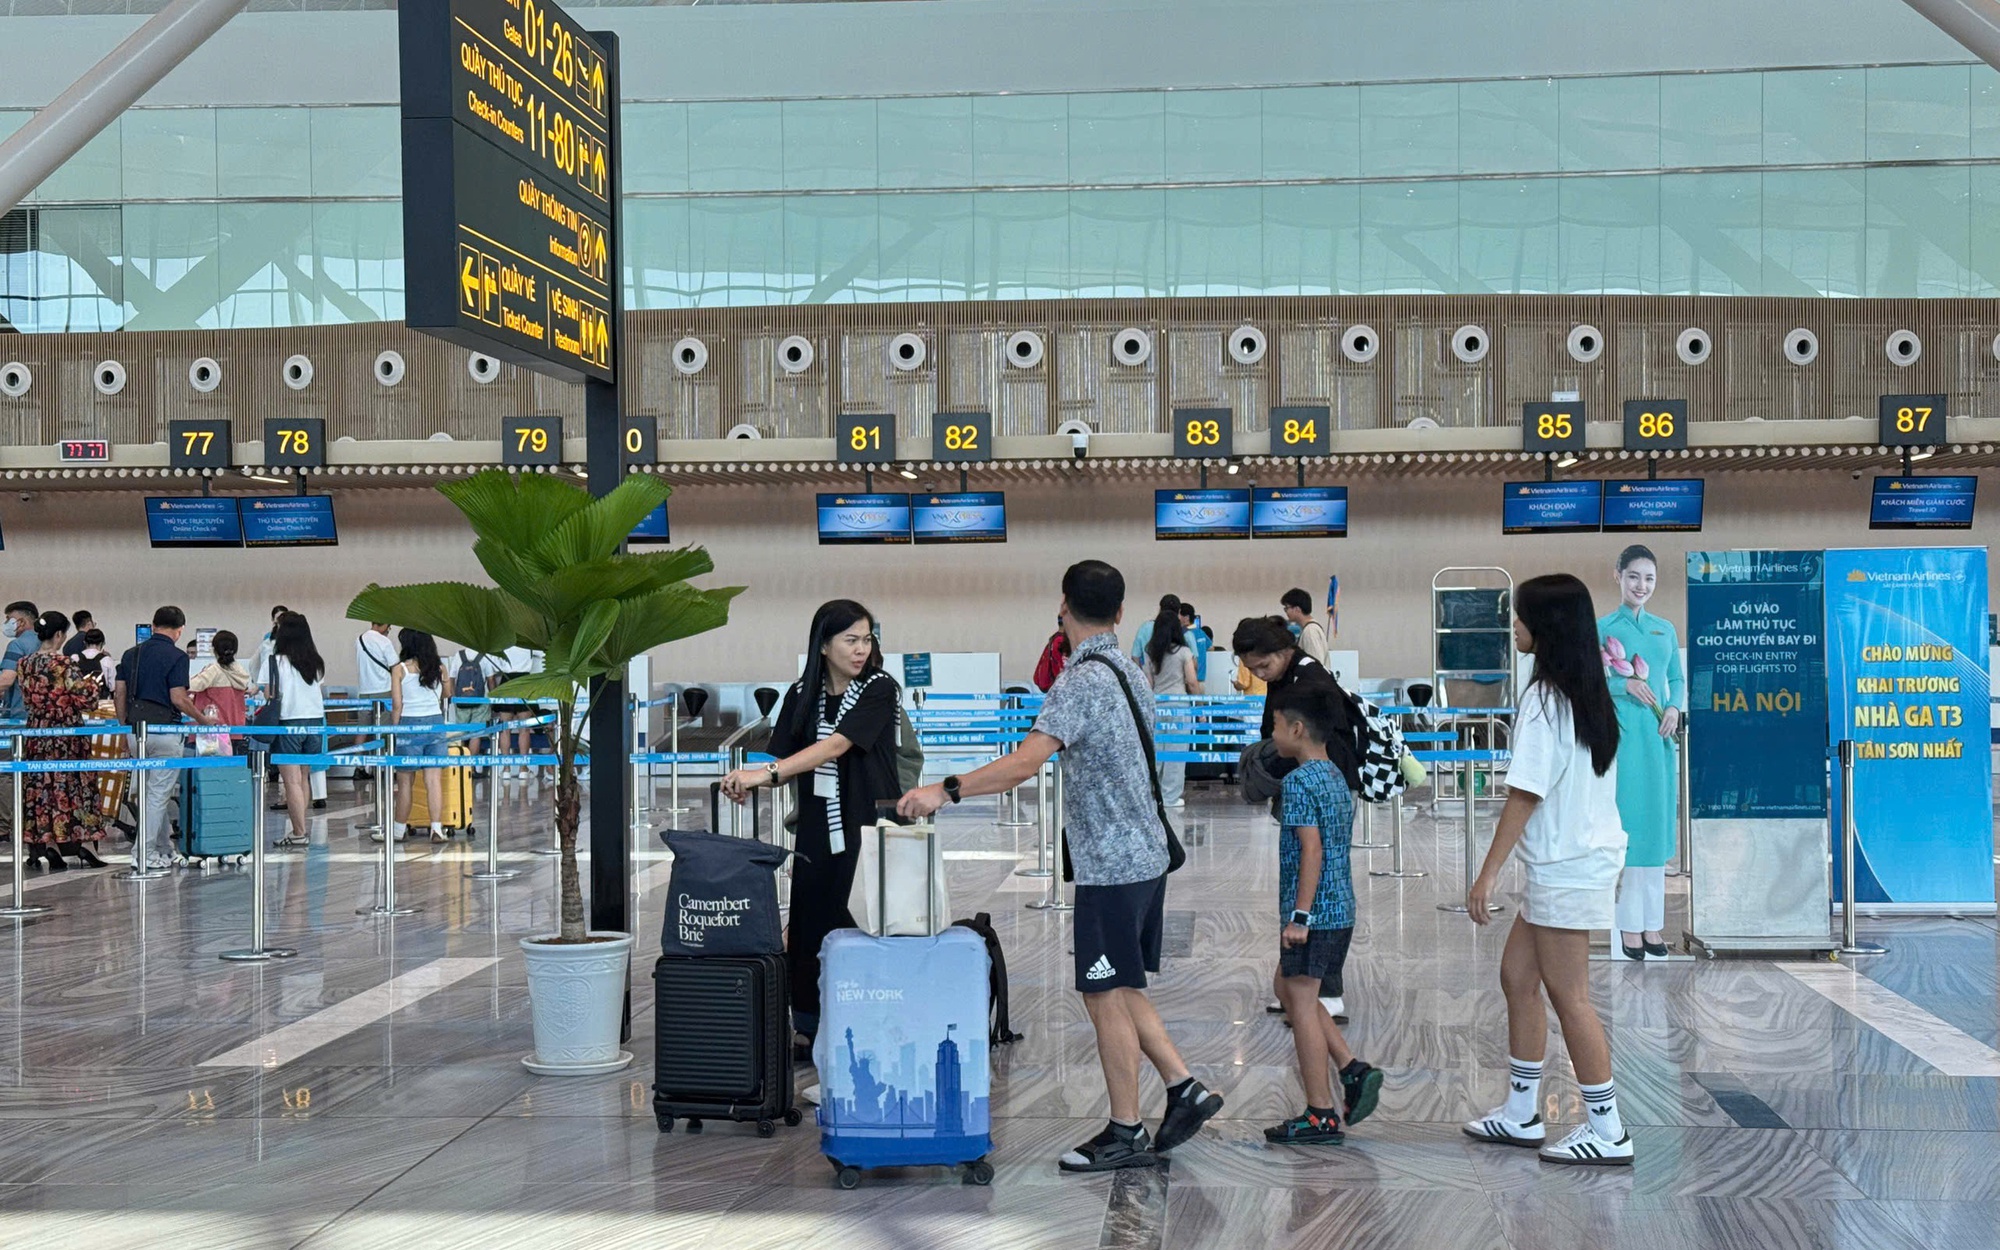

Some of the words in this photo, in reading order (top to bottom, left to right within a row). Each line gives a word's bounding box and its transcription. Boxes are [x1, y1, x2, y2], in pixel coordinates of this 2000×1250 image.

[504, 18, 522, 49] Gates
[524, 0, 573, 87] 01-26
[461, 42, 487, 81] QUẦY
[487, 63, 505, 94] THỦ
[506, 74, 524, 109] TỤC
[468, 90, 497, 126] Check-in
[497, 109, 525, 144] Counters
[527, 93, 575, 176] 11-80
[518, 178, 540, 211] QUẦY
[541, 192, 565, 225] THÔNG
[565, 208, 578, 233] TIN
[549, 234, 578, 267] Information
[502, 263, 524, 297] QUẦY
[525, 275, 537, 302] VÉ
[551, 288, 563, 319] VỆ
[563, 294, 579, 321] SINH
[502, 306, 521, 332] Ticket
[521, 314, 544, 340] Counter
[555, 328, 580, 355] Restroom
[1283, 419, 1317, 444] 84
[1537, 413, 1573, 439] 85
[1639, 412, 1674, 438] 86
[1896, 407, 1932, 432] 87
[182, 431, 215, 455] 77
[277, 430, 310, 455] 78
[515, 428, 548, 452] 79
[625, 428, 643, 453] 0
[851, 426, 880, 450] 81
[945, 425, 978, 450] 82
[1186, 420, 1220, 445] 83
[1529, 502, 1553, 510] KHÁCH
[1718, 563, 1760, 573] Vietnam
[1760, 563, 1798, 572] Airlines
[1866, 572, 1911, 581] Vietnam
[1911, 571, 1951, 580] Airlines
[1733, 601, 1752, 614] LỐI
[1754, 601, 1780, 614] VÀO
[1716, 618, 1742, 630] LÀM
[1744, 616, 1770, 630] THỦ
[1772, 619, 1797, 632] TỤC
[1696, 635, 1723, 646] CHO
[1725, 632, 1775, 645] CHUYẾN
[1778, 635, 1801, 645] BAY
[1803, 634, 1817, 645] ĐI
[1715, 651, 1763, 661] CHECK-IN
[1765, 651, 1798, 660] ENTRY
[1862, 643, 1902, 662] CHÀO
[1905, 643, 1953, 662] MỪNG
[1716, 664, 1737, 673] FOR
[1740, 664, 1781, 673] FLIGHTS
[1782, 664, 1797, 673] TO
[1857, 677, 1894, 693] KHAI
[1896, 675, 1960, 693] TRƯƠNG
[1713, 688, 1749, 712] HÀ
[1756, 688, 1801, 717] NỘI
[1855, 701, 1900, 727] NHÀ
[1904, 705, 1934, 727] GA
[1938, 705, 1963, 727] T3
[286, 726, 307, 734] TIA
[1214, 735, 1239, 743] TIA
[1199, 752, 1222, 762] TIA
[1490, 750, 1512, 760] TIA
[1857, 740, 1886, 758] TÂN
[1888, 742, 1919, 758] SƠN
[1923, 738, 1963, 758] NHẤT
[80, 760, 134, 769] INTERNATIONAL
[333, 756, 362, 765] TIA
[678, 893, 751, 912] Camembert
[678, 909, 741, 930] Roquefort
[678, 925, 704, 942] Brie
[1086, 967, 1116, 980] adidas
[836, 989, 865, 1003] NEW
[866, 989, 904, 1001] YORK
